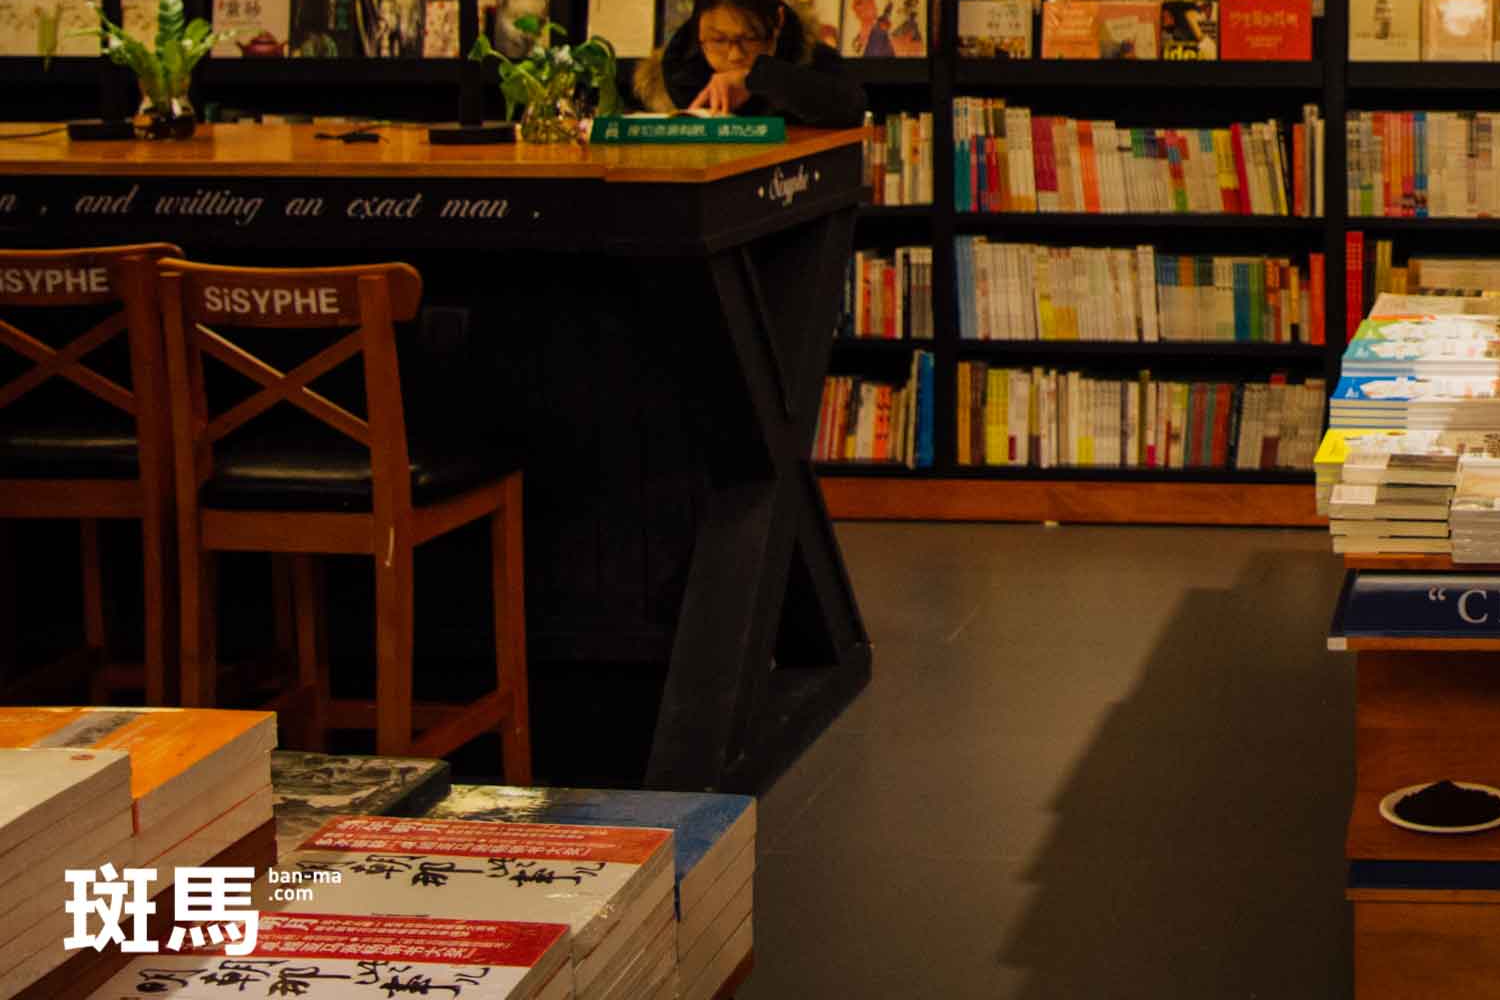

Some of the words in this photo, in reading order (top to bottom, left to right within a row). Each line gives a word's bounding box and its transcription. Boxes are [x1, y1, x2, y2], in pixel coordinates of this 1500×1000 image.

[75, 184, 140, 215] and
[284, 195, 325, 217] an
[440, 199, 510, 219] man
